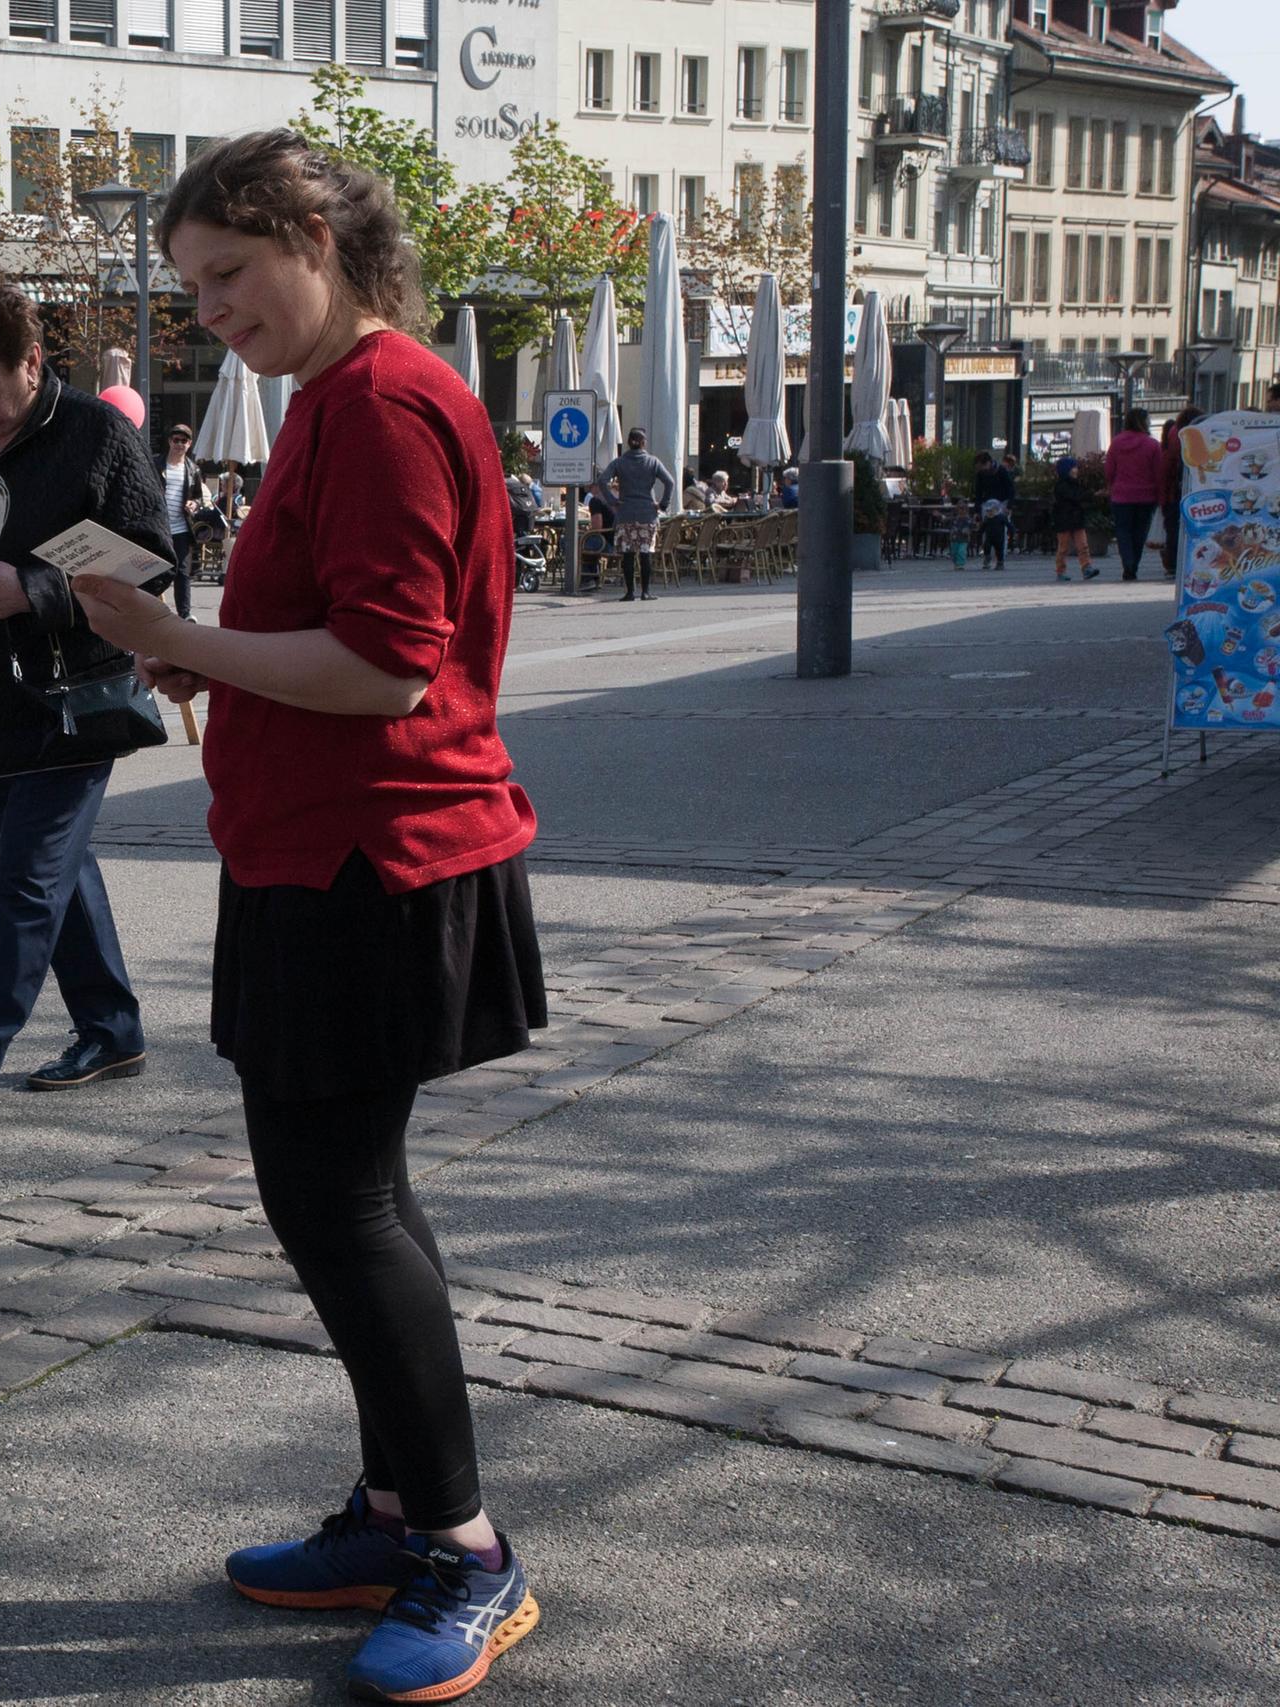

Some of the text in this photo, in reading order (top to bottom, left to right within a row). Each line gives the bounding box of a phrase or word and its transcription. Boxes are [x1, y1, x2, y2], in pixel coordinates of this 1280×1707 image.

[455, 103, 540, 141] souSol
[559, 397, 581, 406] ZONE
[1189, 503, 1225, 518] Frisco
